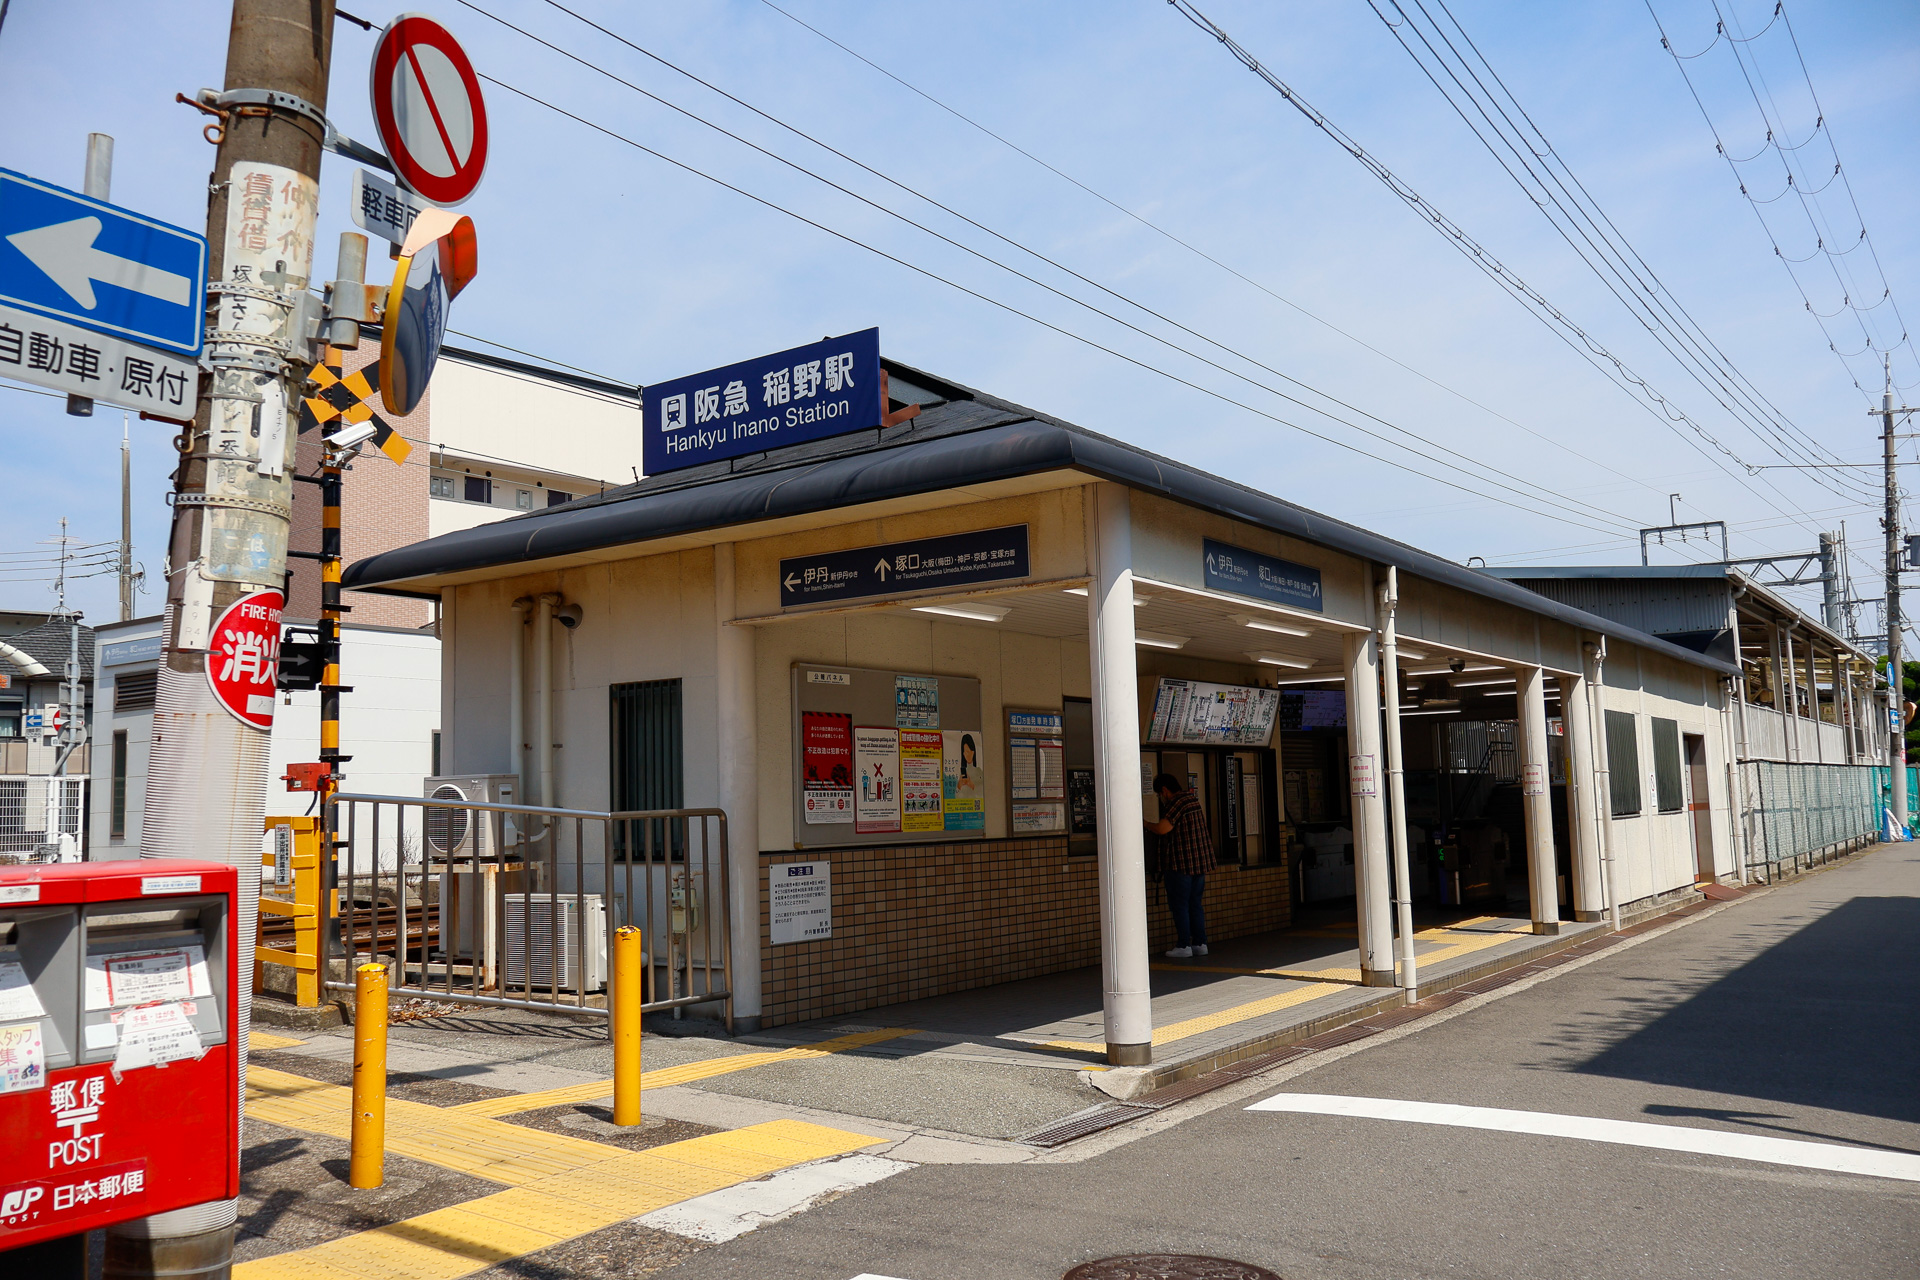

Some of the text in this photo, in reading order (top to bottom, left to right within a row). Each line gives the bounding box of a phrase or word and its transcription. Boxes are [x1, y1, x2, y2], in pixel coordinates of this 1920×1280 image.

[694, 352, 855, 424] 阪急 稲野駅
[666, 399, 849, 454] Hankyu Inano Station
[895, 553, 920, 572] 塚口
[1218, 554, 1233, 573] 伊丹
[803, 566, 858, 585] 伊丹 新伊丹ゆき
[1258, 565, 1271, 582] 塚口
[240, 603, 267, 620] FIRE
[790, 866, 811, 876] ご注意
[0, 1029, 32, 1046] タッフ
[50, 1076, 105, 1114] 郵便
[49, 1133, 105, 1169] POST
[53, 1170, 145, 1212] 日本郵便
